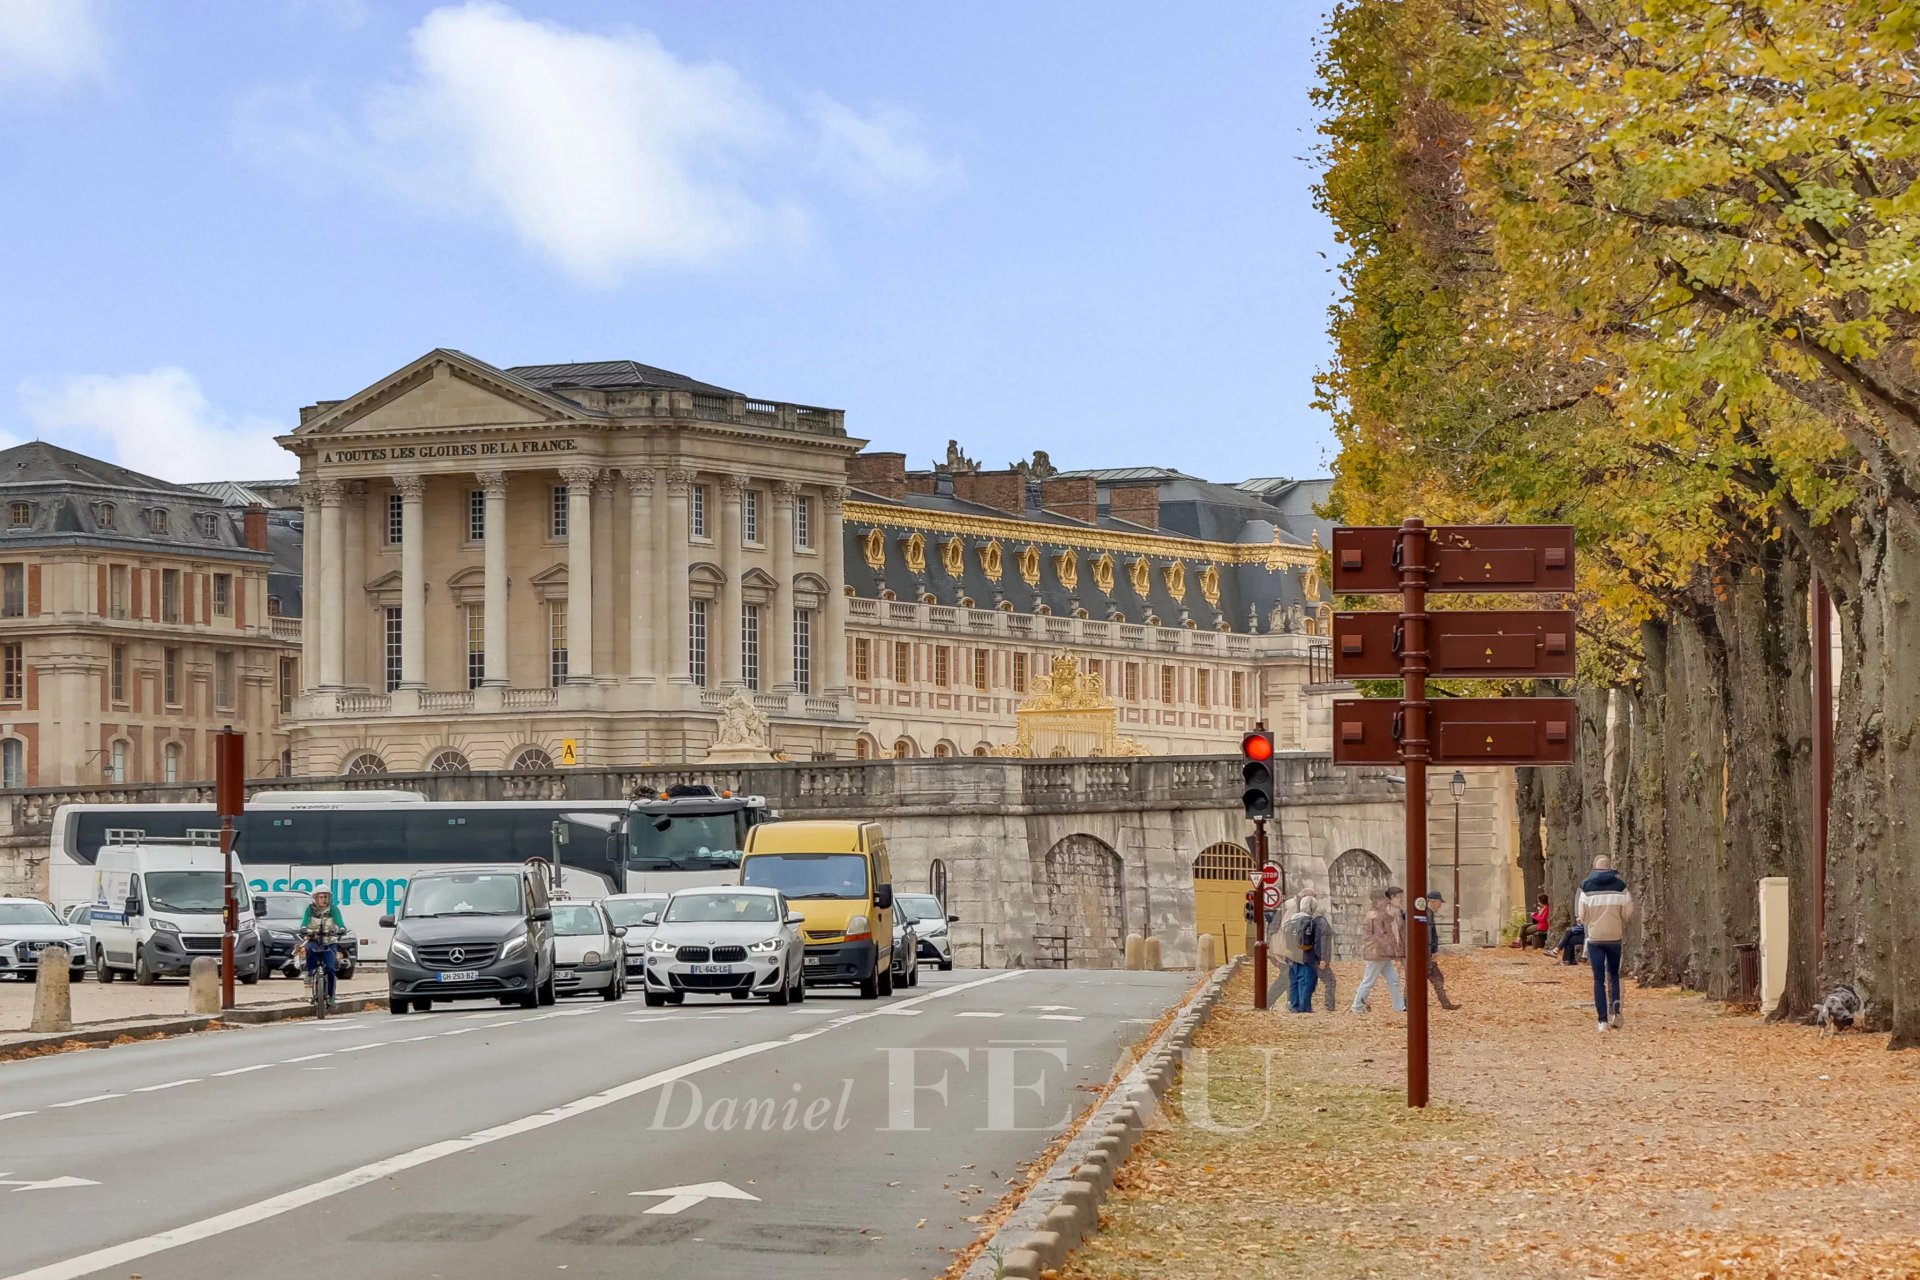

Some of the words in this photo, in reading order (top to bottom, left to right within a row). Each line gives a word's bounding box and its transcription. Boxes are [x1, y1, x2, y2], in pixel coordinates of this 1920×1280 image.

[324, 452, 332, 462] A
[336, 448, 386, 462] TOUTES
[391, 447, 415, 459] LES
[419, 444, 477, 458] GLOIRES
[481, 443, 498, 455] DE
[500, 442, 518, 454] LA
[564, 744, 574, 759] A
